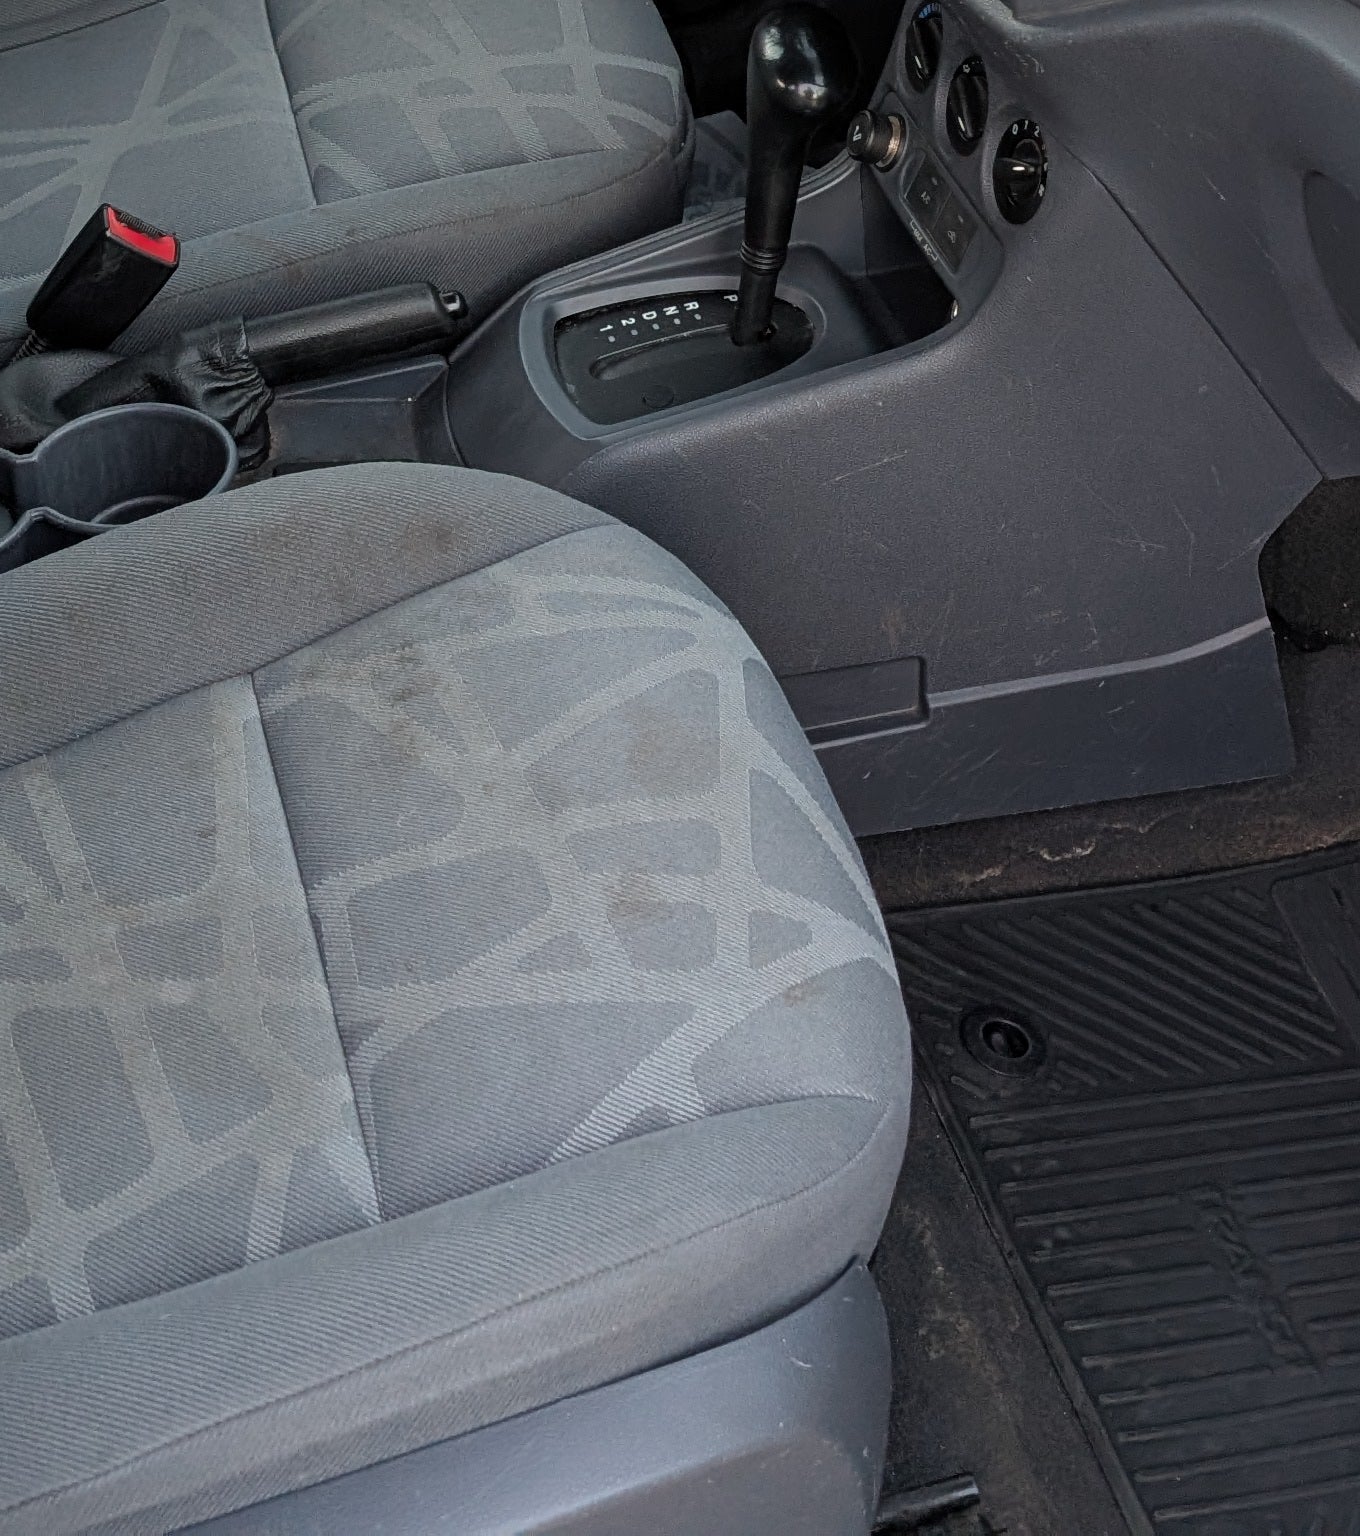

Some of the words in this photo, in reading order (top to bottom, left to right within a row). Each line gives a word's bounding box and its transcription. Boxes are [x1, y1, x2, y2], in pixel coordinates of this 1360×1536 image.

[724, 294, 738, 302] P
[684, 301, 699, 311] R
[642, 311, 657, 320] D
[663, 306, 679, 316] N
[621, 318, 635, 326] 2
